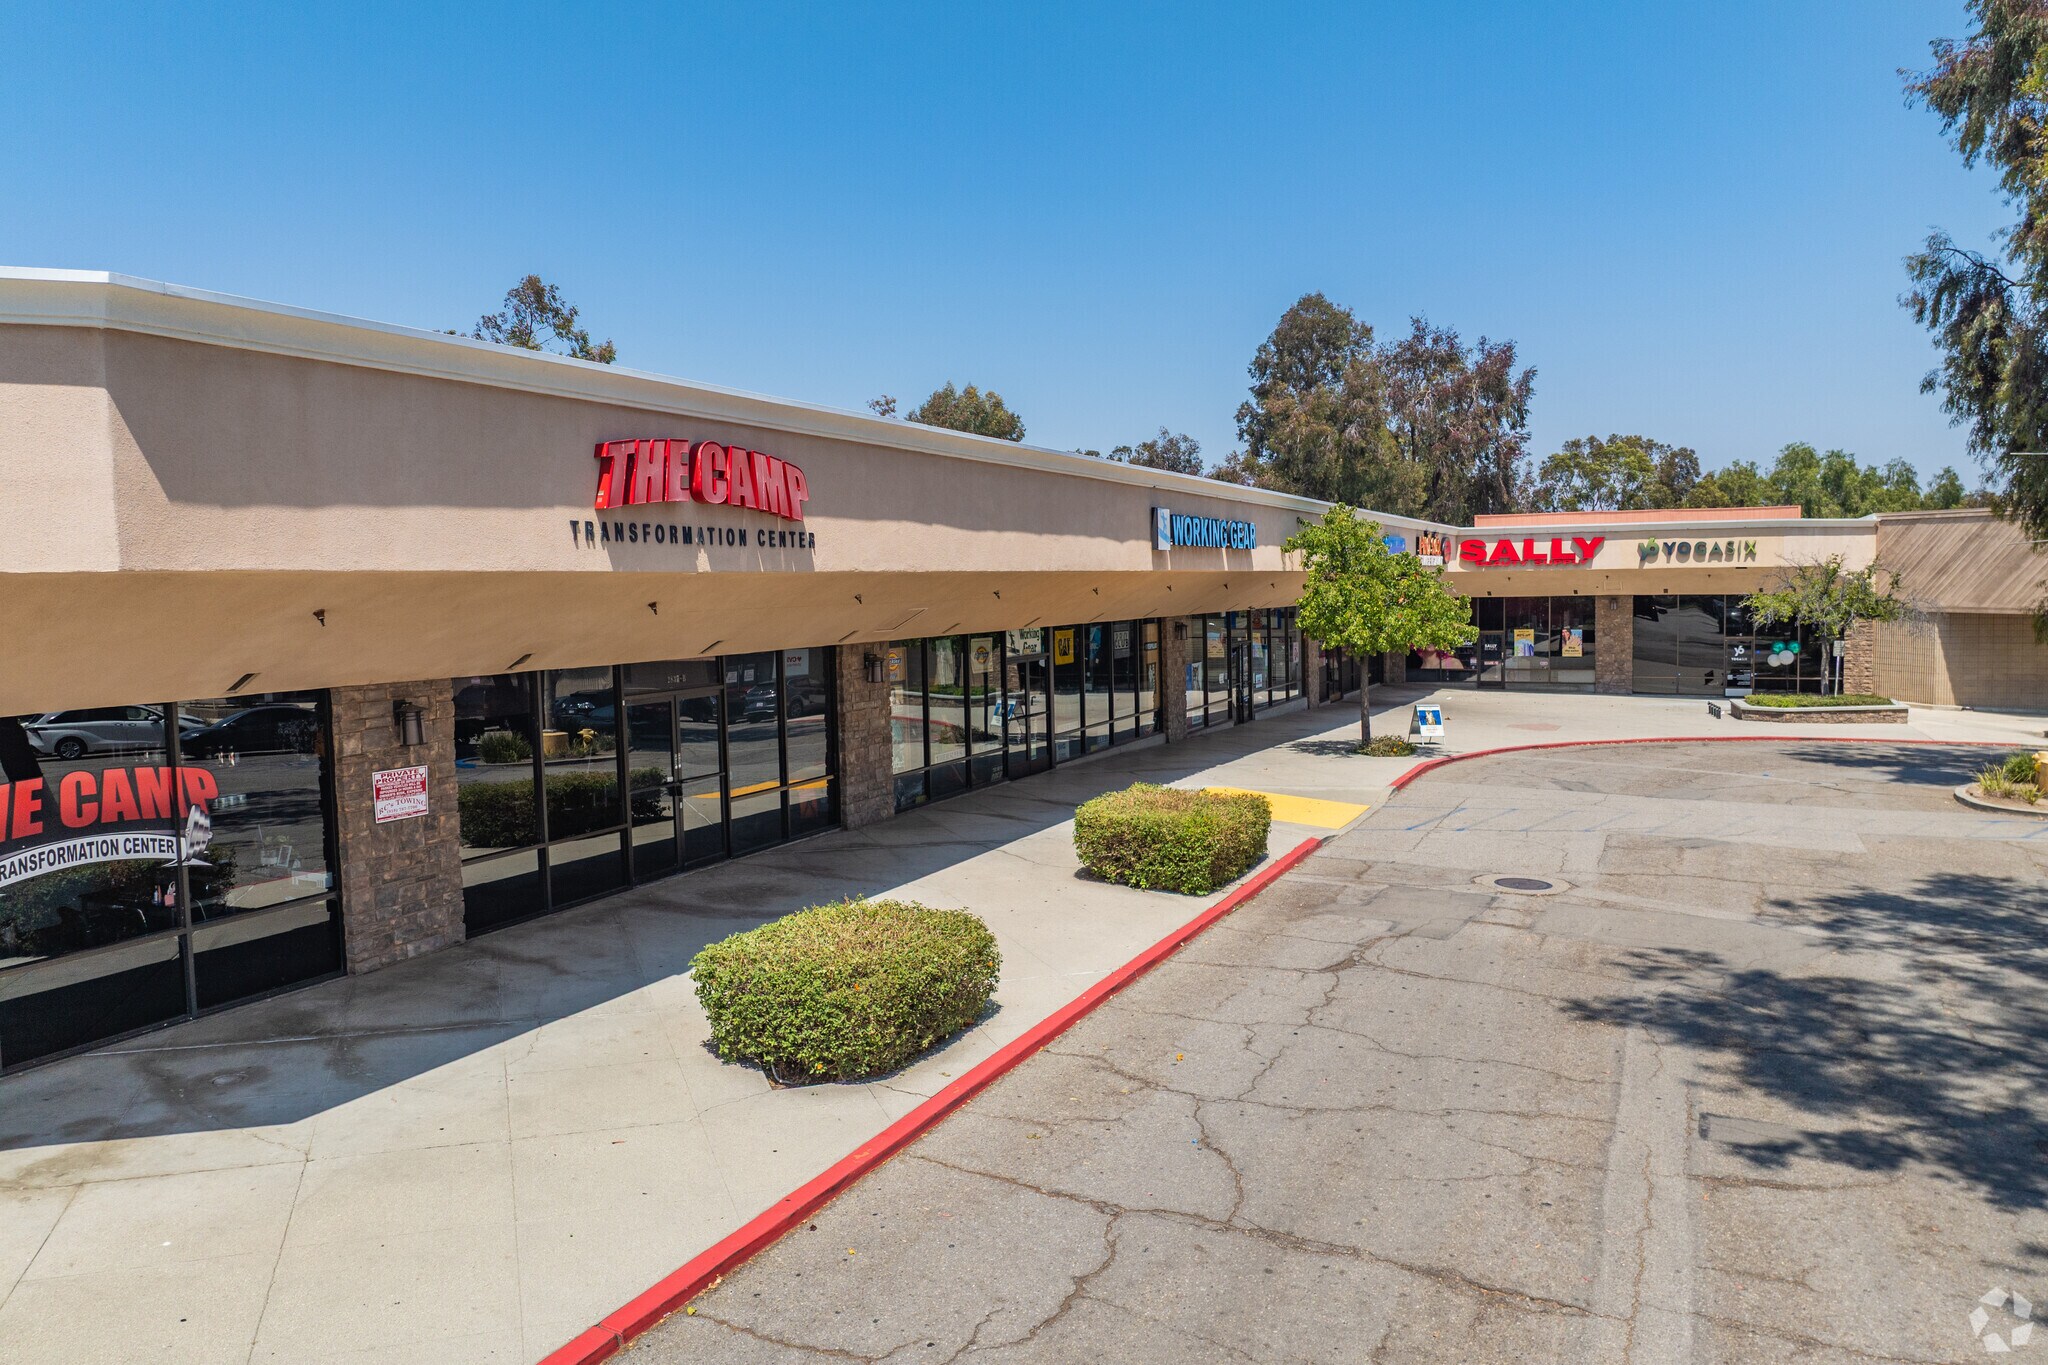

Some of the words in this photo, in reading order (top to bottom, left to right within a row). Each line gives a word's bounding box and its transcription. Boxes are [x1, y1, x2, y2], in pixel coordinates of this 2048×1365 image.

[595, 438, 690, 509] THE
[690, 440, 809, 522] CAMP
[570, 520, 748, 547] TRANSFORMATION
[757, 529, 816, 549] CENTER
[1171, 514, 1228, 548] WORKING
[1230, 520, 1257, 549] GEAR
[1460, 537, 1605, 562] SALLY
[1058, 638, 1070, 657] CAT
[375, 772, 424, 784] PROPERTY
[380, 768, 419, 779] PRIVATE
[59, 767, 219, 828] CAMP
[395, 797, 426, 807] TOWING
[123, 839, 175, 855] CENTER
